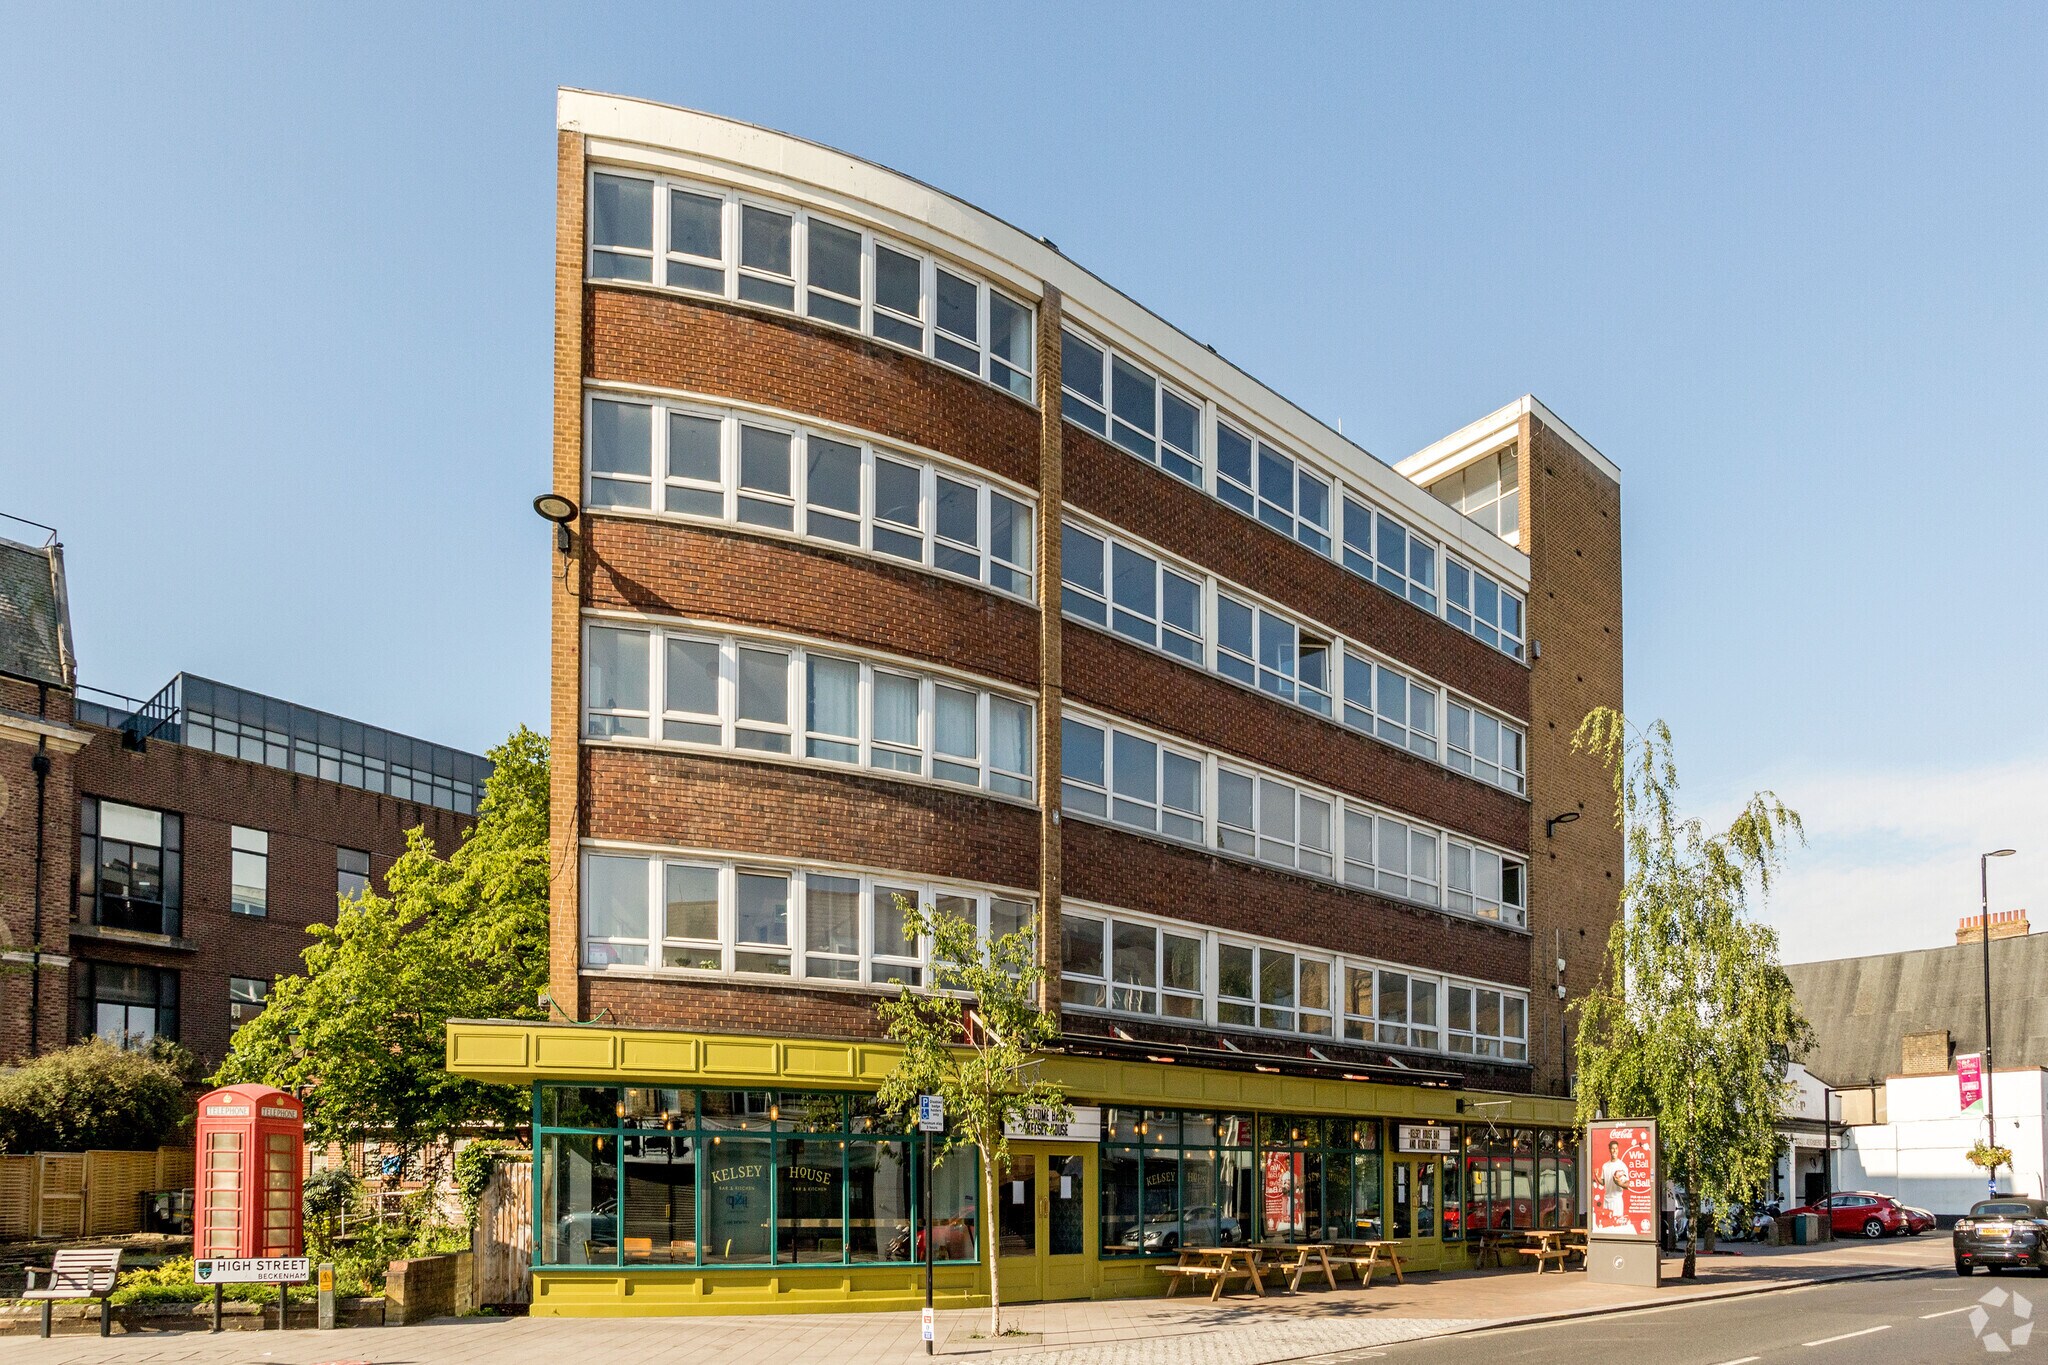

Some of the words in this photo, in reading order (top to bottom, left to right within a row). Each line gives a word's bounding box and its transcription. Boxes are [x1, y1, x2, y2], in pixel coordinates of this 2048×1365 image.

[923, 1097, 929, 1107] P
[208, 1106, 248, 1115] TELEPHONE
[262, 1107, 296, 1118] TELEPHONE
[1629, 1151, 1645, 1159] Win
[1635, 1160, 1648, 1168] Ball
[711, 1165, 762, 1184] KELSEY
[789, 1166, 831, 1185] HOUSE
[1146, 1171, 1176, 1186] KELSEY
[1629, 1170, 1646, 1178] Give
[1636, 1179, 1650, 1187] Ball
[217, 1260, 251, 1271] HIGH
[256, 1260, 306, 1270] STREET
[258, 1272, 306, 1280] BECKENHAM
